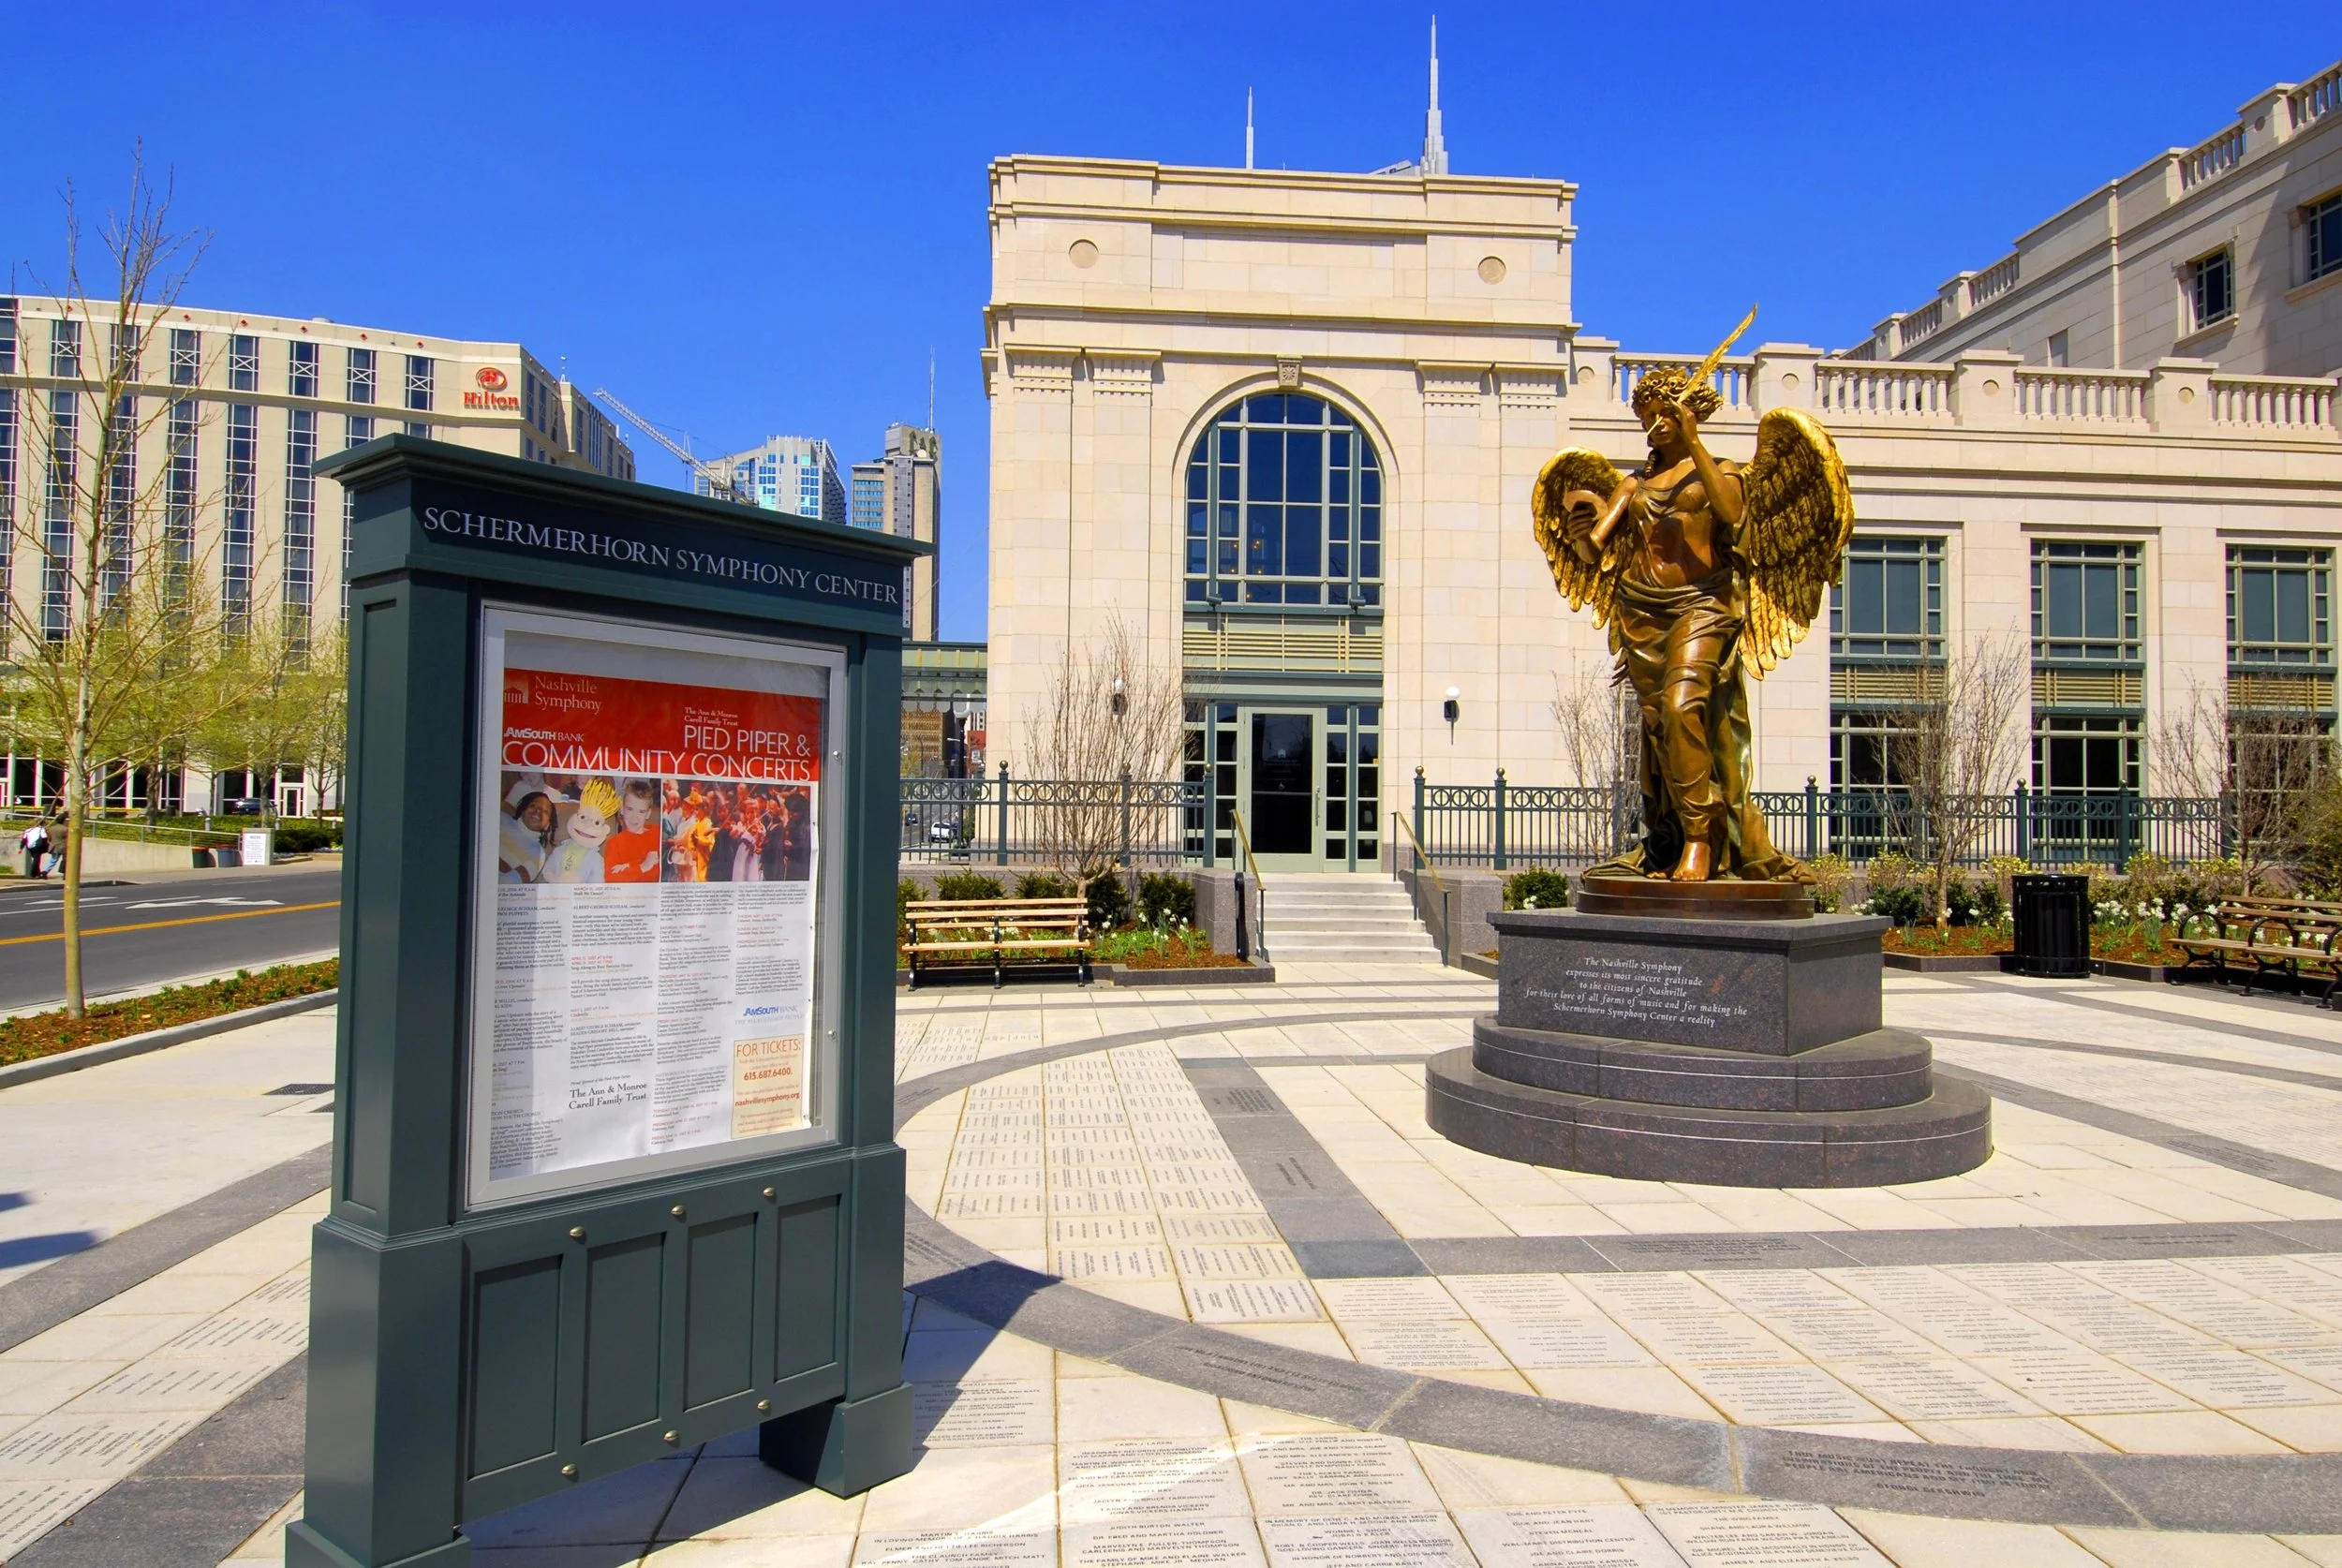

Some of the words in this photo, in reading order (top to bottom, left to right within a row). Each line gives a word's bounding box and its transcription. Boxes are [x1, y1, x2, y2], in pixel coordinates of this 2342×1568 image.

[464, 392, 519, 406] Hilton
[424, 507, 669, 567] SCHERMERHORN
[676, 549, 810, 591] SYMPHONY
[815, 573, 898, 604] CENTER
[535, 675, 597, 694] Nashville
[535, 691, 601, 715] Symphony
[704, 717, 721, 726] Family
[558, 732, 584, 742] BANK
[685, 725, 730, 750] PIED
[737, 730, 791, 755] PIPER
[796, 734, 810, 757] &
[503, 741, 686, 774] COMMUNITY
[691, 755, 811, 782] CONCERTS
[1584, 957, 1599, 966] The
[1602, 958, 1638, 969] Nashville
[1641, 962, 1682, 974] Symphony
[1566, 969, 1599, 979] expresses
[1634, 974, 1661, 983] sincere
[1665, 977, 1702, 986] gratitude
[1604, 984, 1633, 993] citizens
[1636, 984, 1645, 995] of
[1649, 987, 1687, 997] Nashville
[1525, 987, 1537, 998] for
[1540, 989, 1558, 998] their
[1561, 990, 1575, 999] love
[1578, 992, 1586, 1002] of
[1589, 993, 1598, 1001] all
[1601, 994, 1624, 1005] forms
[1627, 997, 1637, 1007] of
[1639, 999, 1662, 1008] music
[1665, 999, 1679, 1009] and
[1682, 1000, 1697, 1013] for
[1700, 1003, 1730, 1016] making
[1734, 1005, 1747, 1015] the
[1554, 1002, 1605, 1014] Schermerhorn
[1608, 1008, 1647, 1021] Symphony
[1650, 1012, 1677, 1021] Center
[736, 1043, 758, 1057] FOR
[761, 1039, 801, 1054] TICKETS:
[570, 1088, 586, 1098] The
[618, 1083, 646, 1091] Monroe
[570, 1098, 594, 1109] Carell
[597, 1094, 623, 1105] Family
